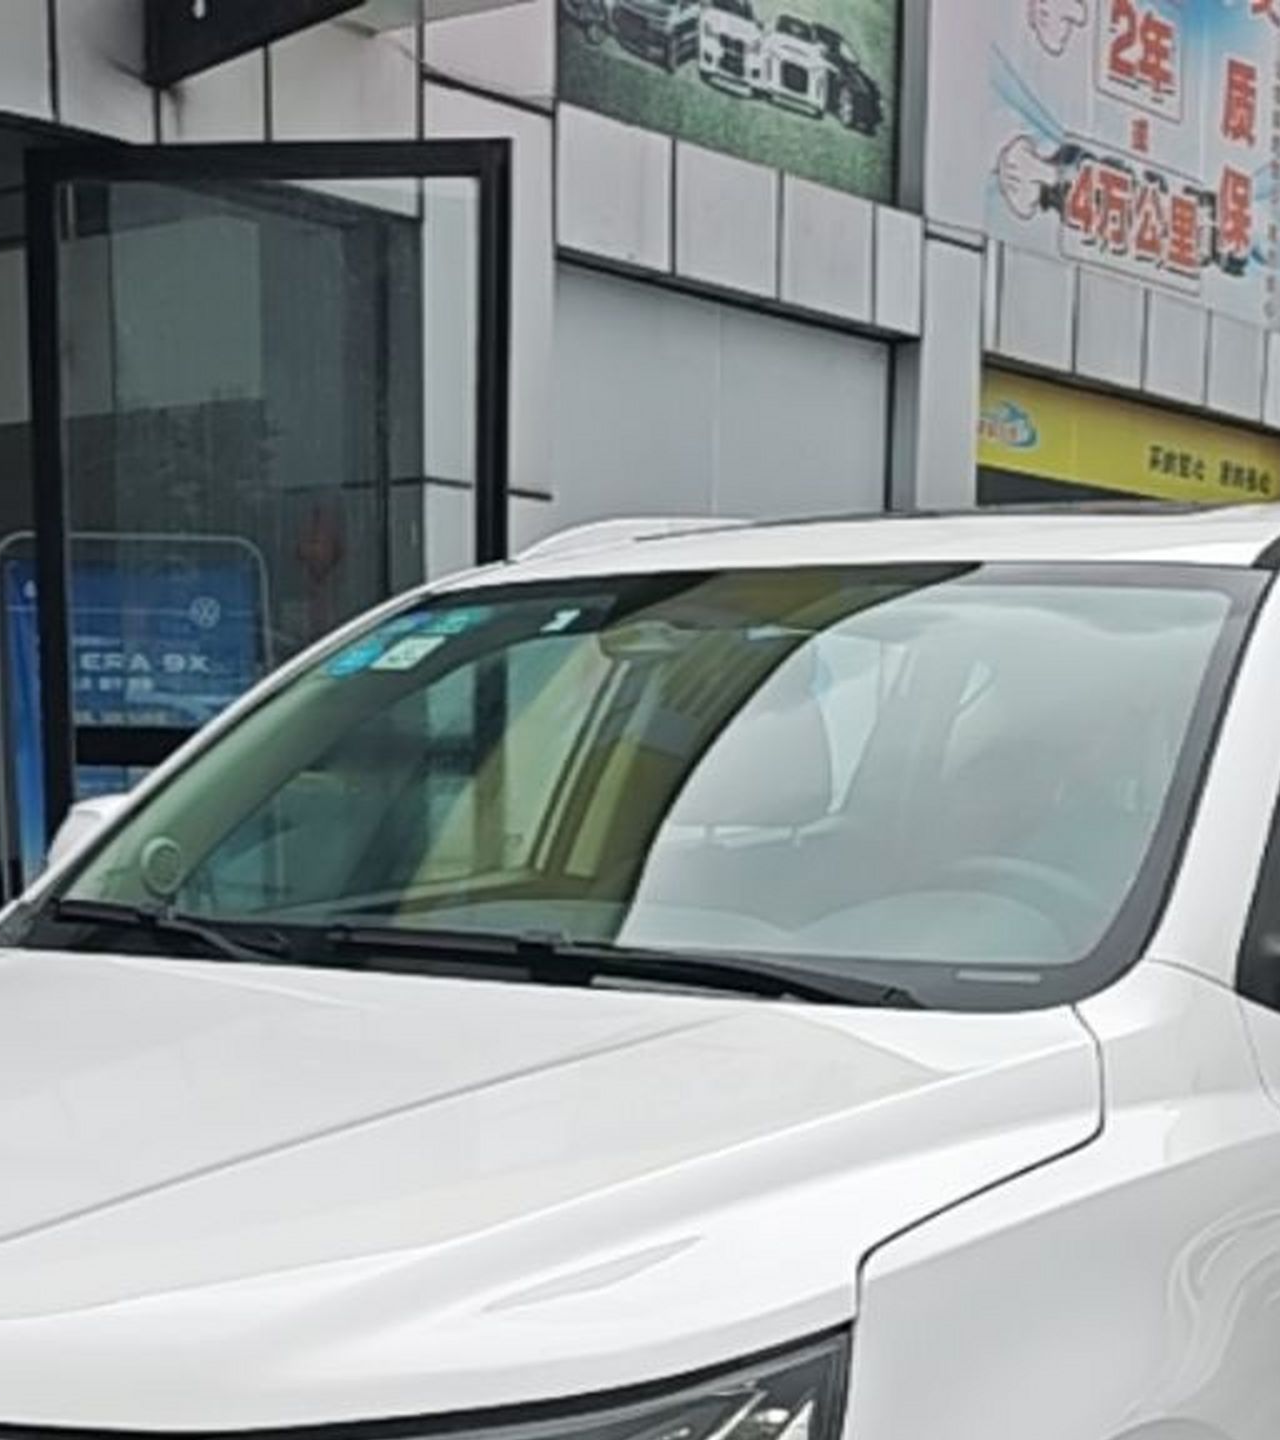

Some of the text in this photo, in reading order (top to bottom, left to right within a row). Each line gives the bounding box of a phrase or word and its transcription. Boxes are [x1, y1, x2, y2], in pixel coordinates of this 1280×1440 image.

[1108, 0, 1175, 93] 2年
[1066, 163, 1198, 272] 4万公里
